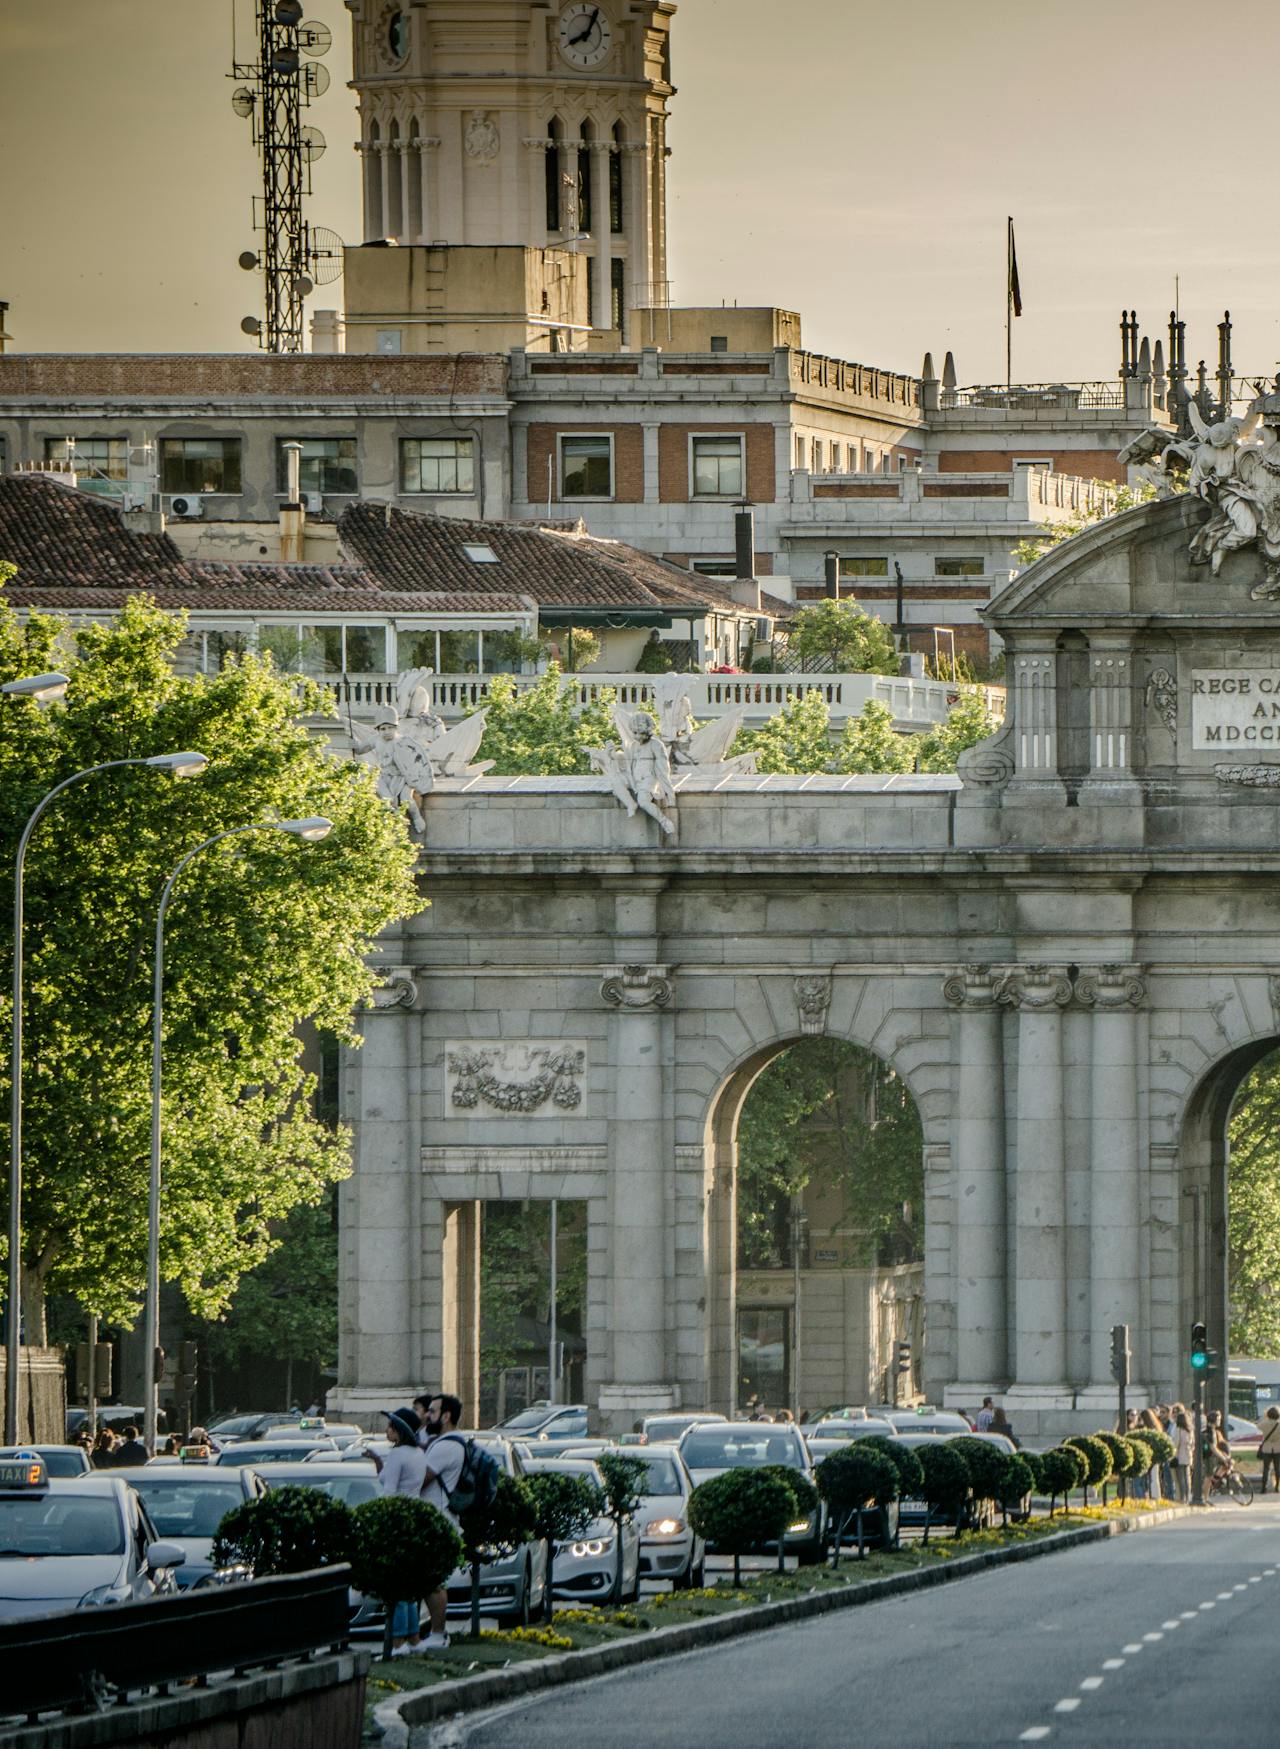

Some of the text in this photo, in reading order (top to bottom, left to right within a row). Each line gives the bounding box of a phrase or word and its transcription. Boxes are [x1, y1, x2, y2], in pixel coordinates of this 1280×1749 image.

[1192, 678, 1251, 694] REGE
[0, 1464, 41, 1484] TAXI 2
